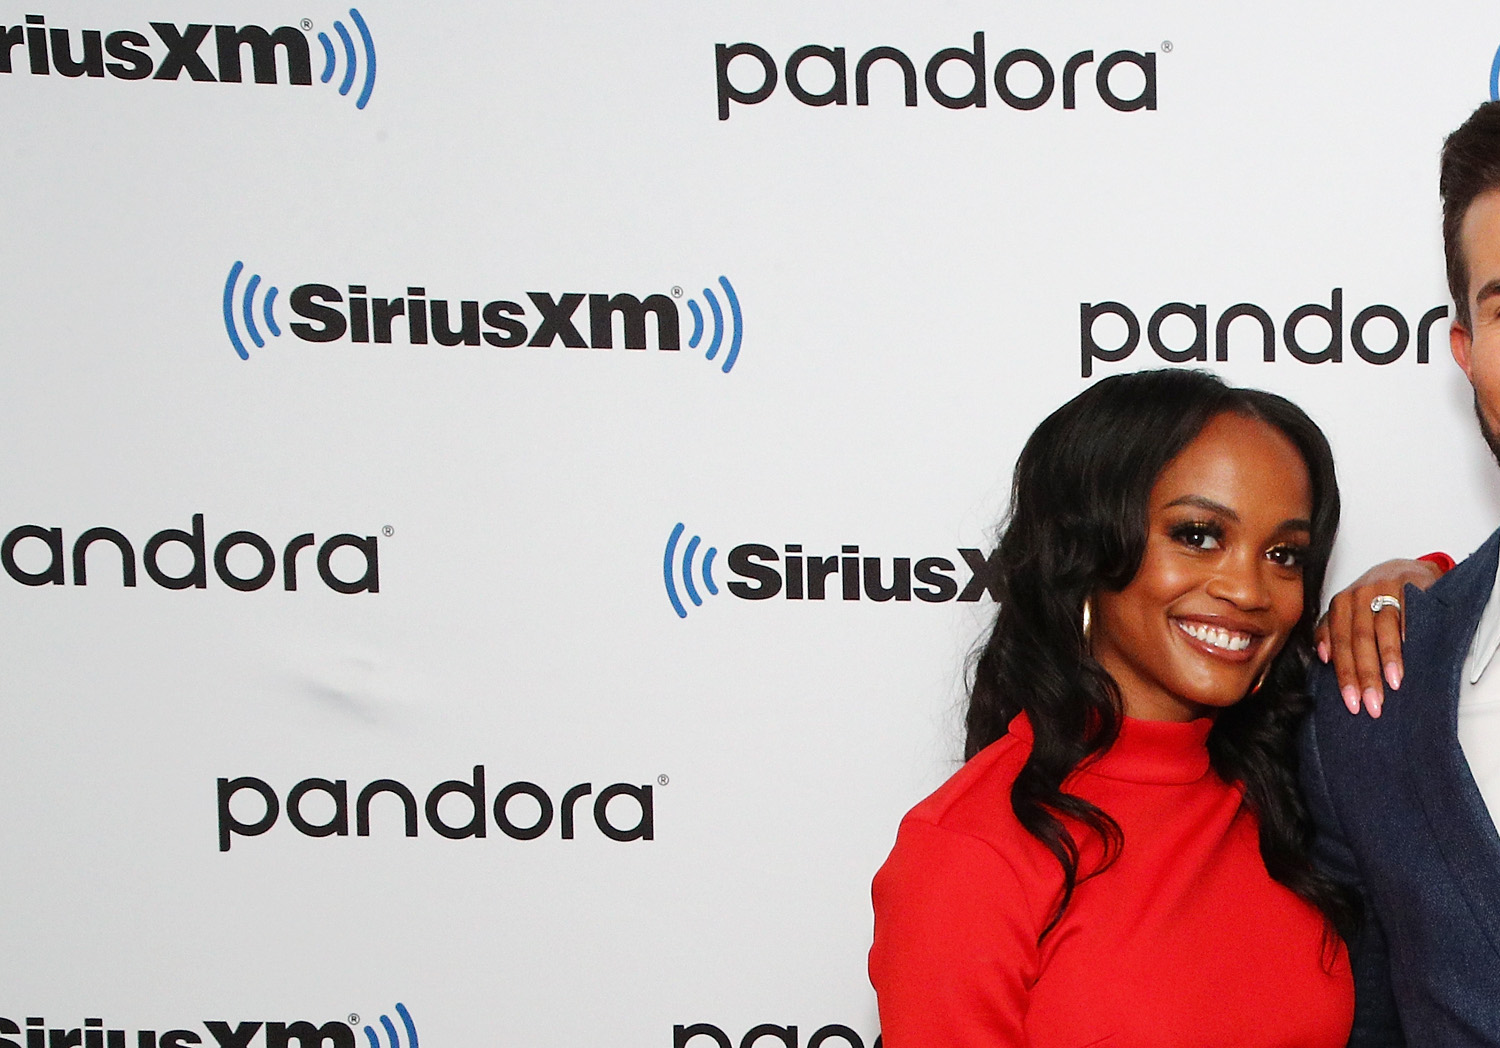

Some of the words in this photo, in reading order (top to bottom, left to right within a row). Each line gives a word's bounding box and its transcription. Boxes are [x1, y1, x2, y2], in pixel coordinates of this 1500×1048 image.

[715, 32, 1156, 120] pandora
[1081, 288, 1449, 378] pandor
[1, 514, 379, 594] andora
[217, 765, 653, 852] pandora
